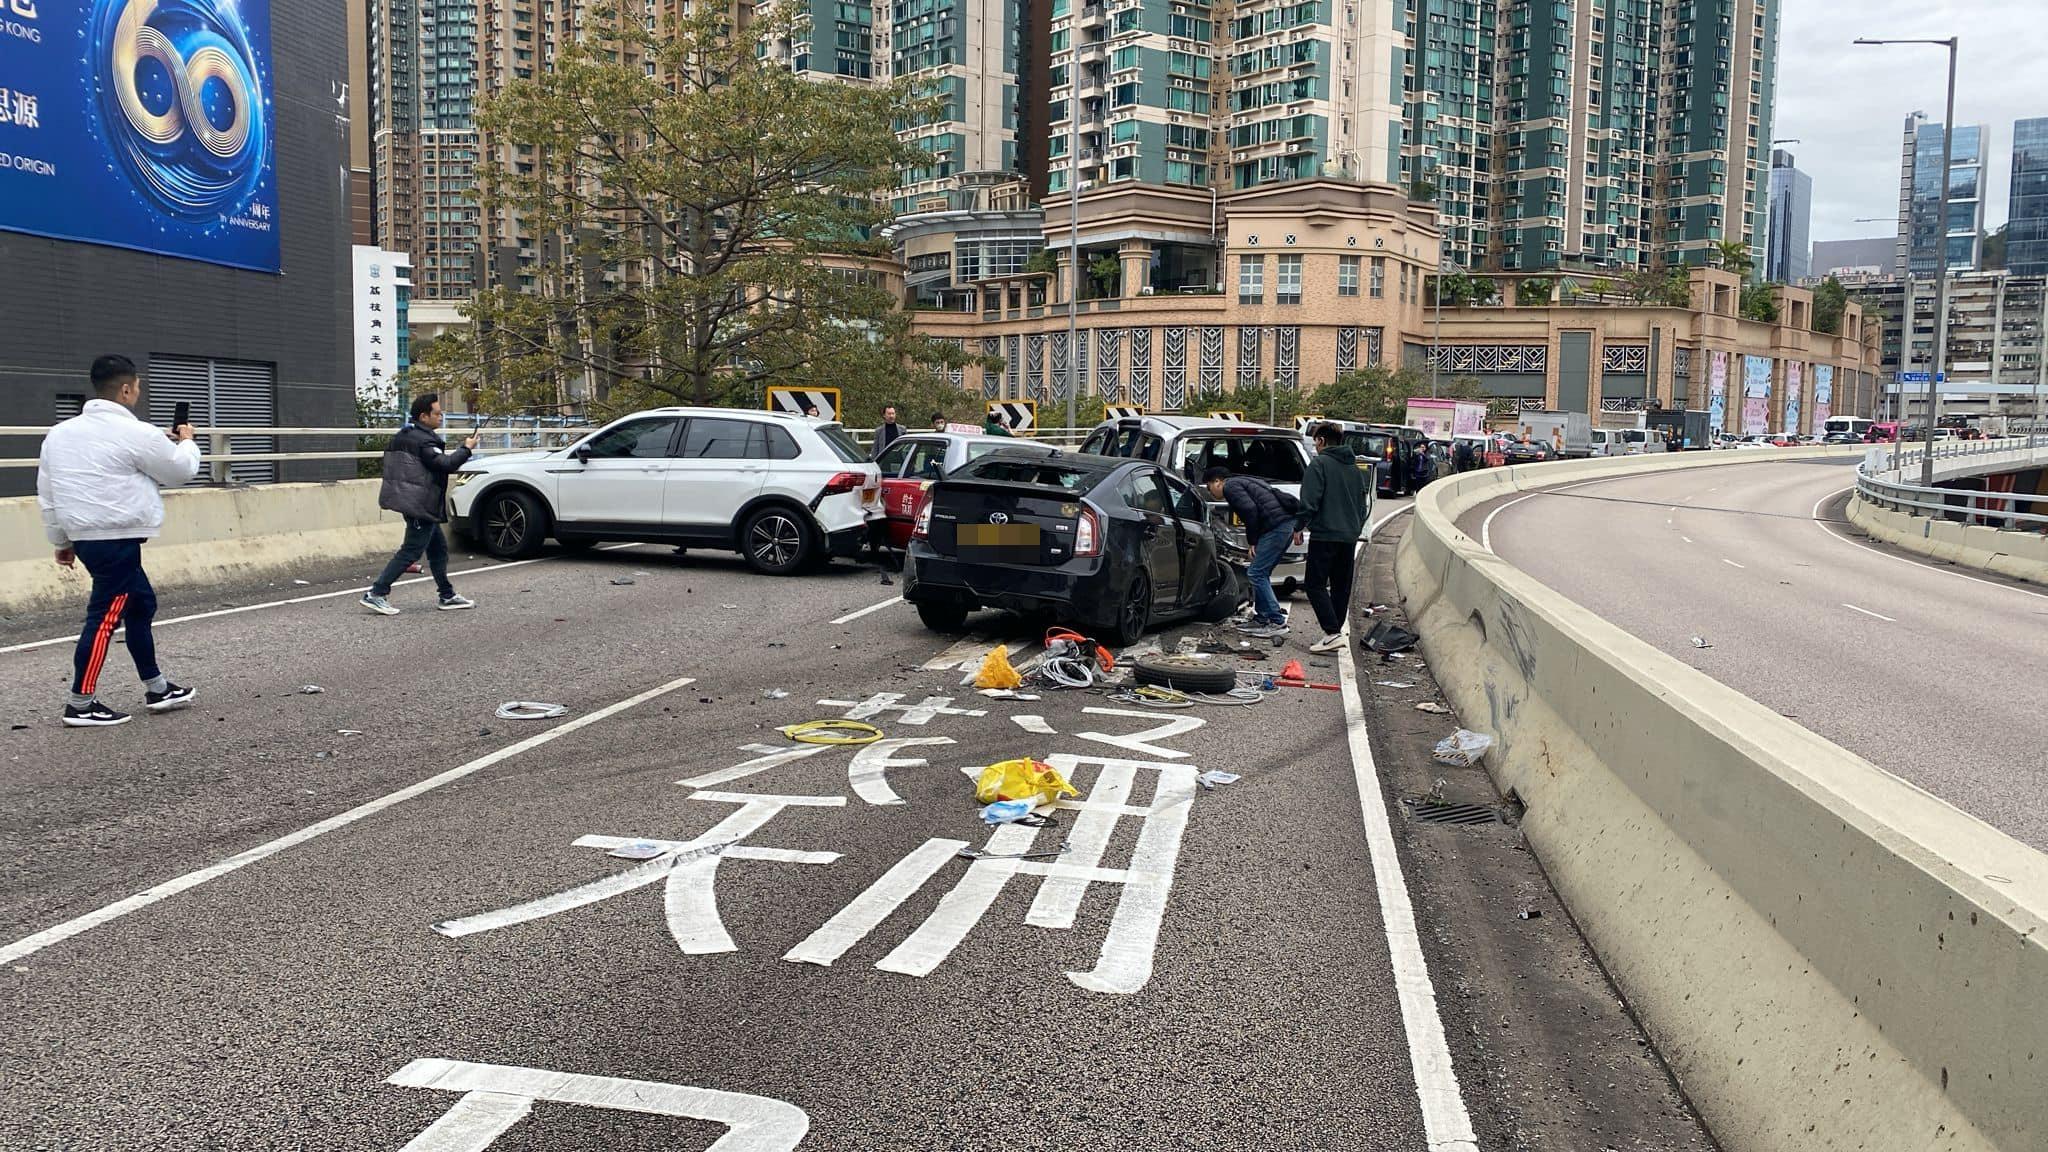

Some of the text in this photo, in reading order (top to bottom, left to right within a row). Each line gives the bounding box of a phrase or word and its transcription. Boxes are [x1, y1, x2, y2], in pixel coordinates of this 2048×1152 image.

[6, 20, 41, 42] KONG
[14, 155, 56, 176] ORIGIN
[229, 216, 271, 232] ANNIVERSARY
